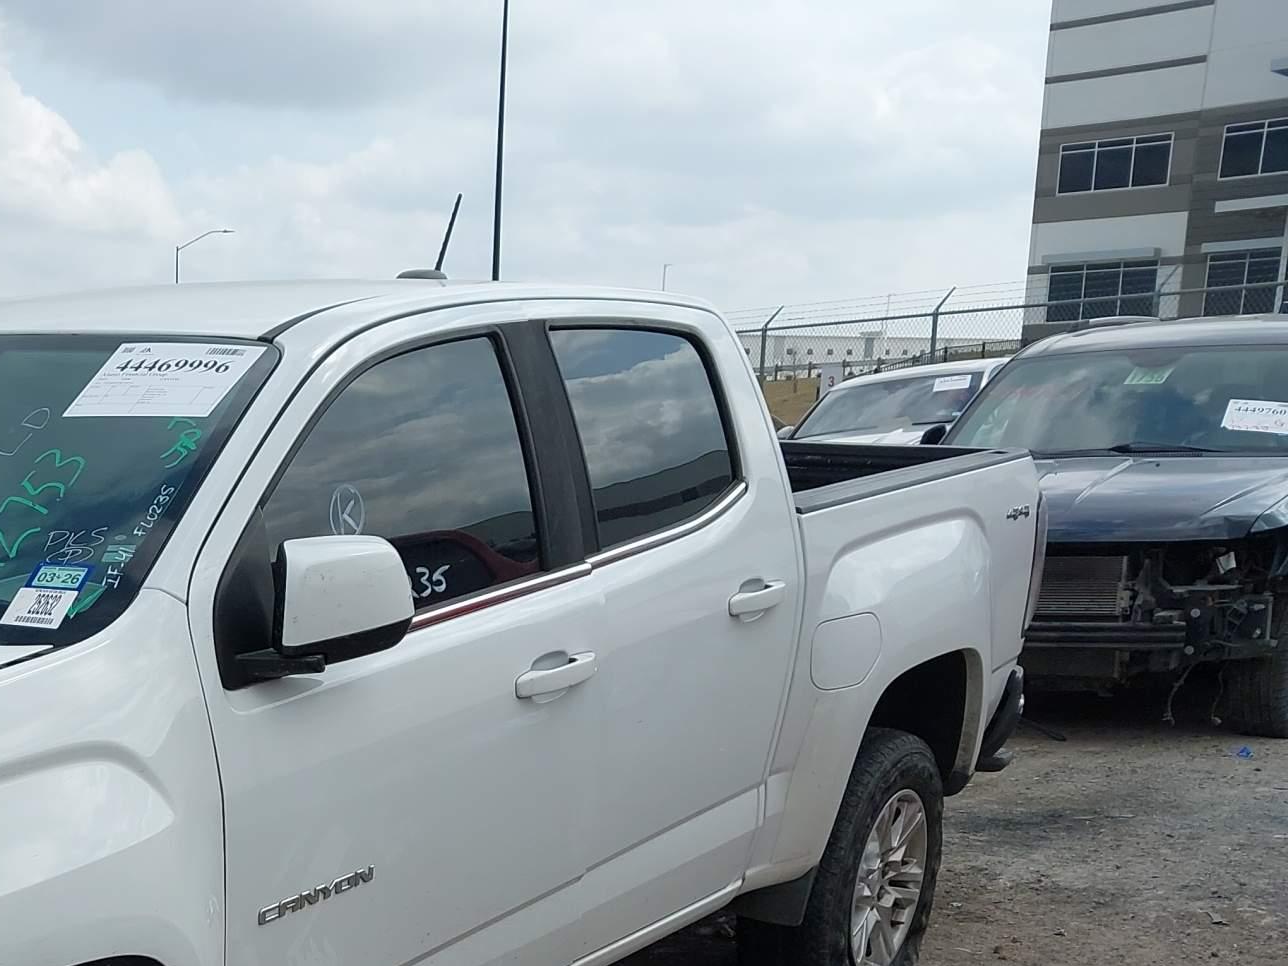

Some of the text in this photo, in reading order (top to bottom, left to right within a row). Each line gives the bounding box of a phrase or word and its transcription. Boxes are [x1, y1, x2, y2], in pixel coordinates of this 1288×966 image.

[115, 357, 237, 374] 44469996
[827, 375, 834, 388] 3
[37, 572, 81, 585] 03 26
[257, 864, 375, 926] CANYON
